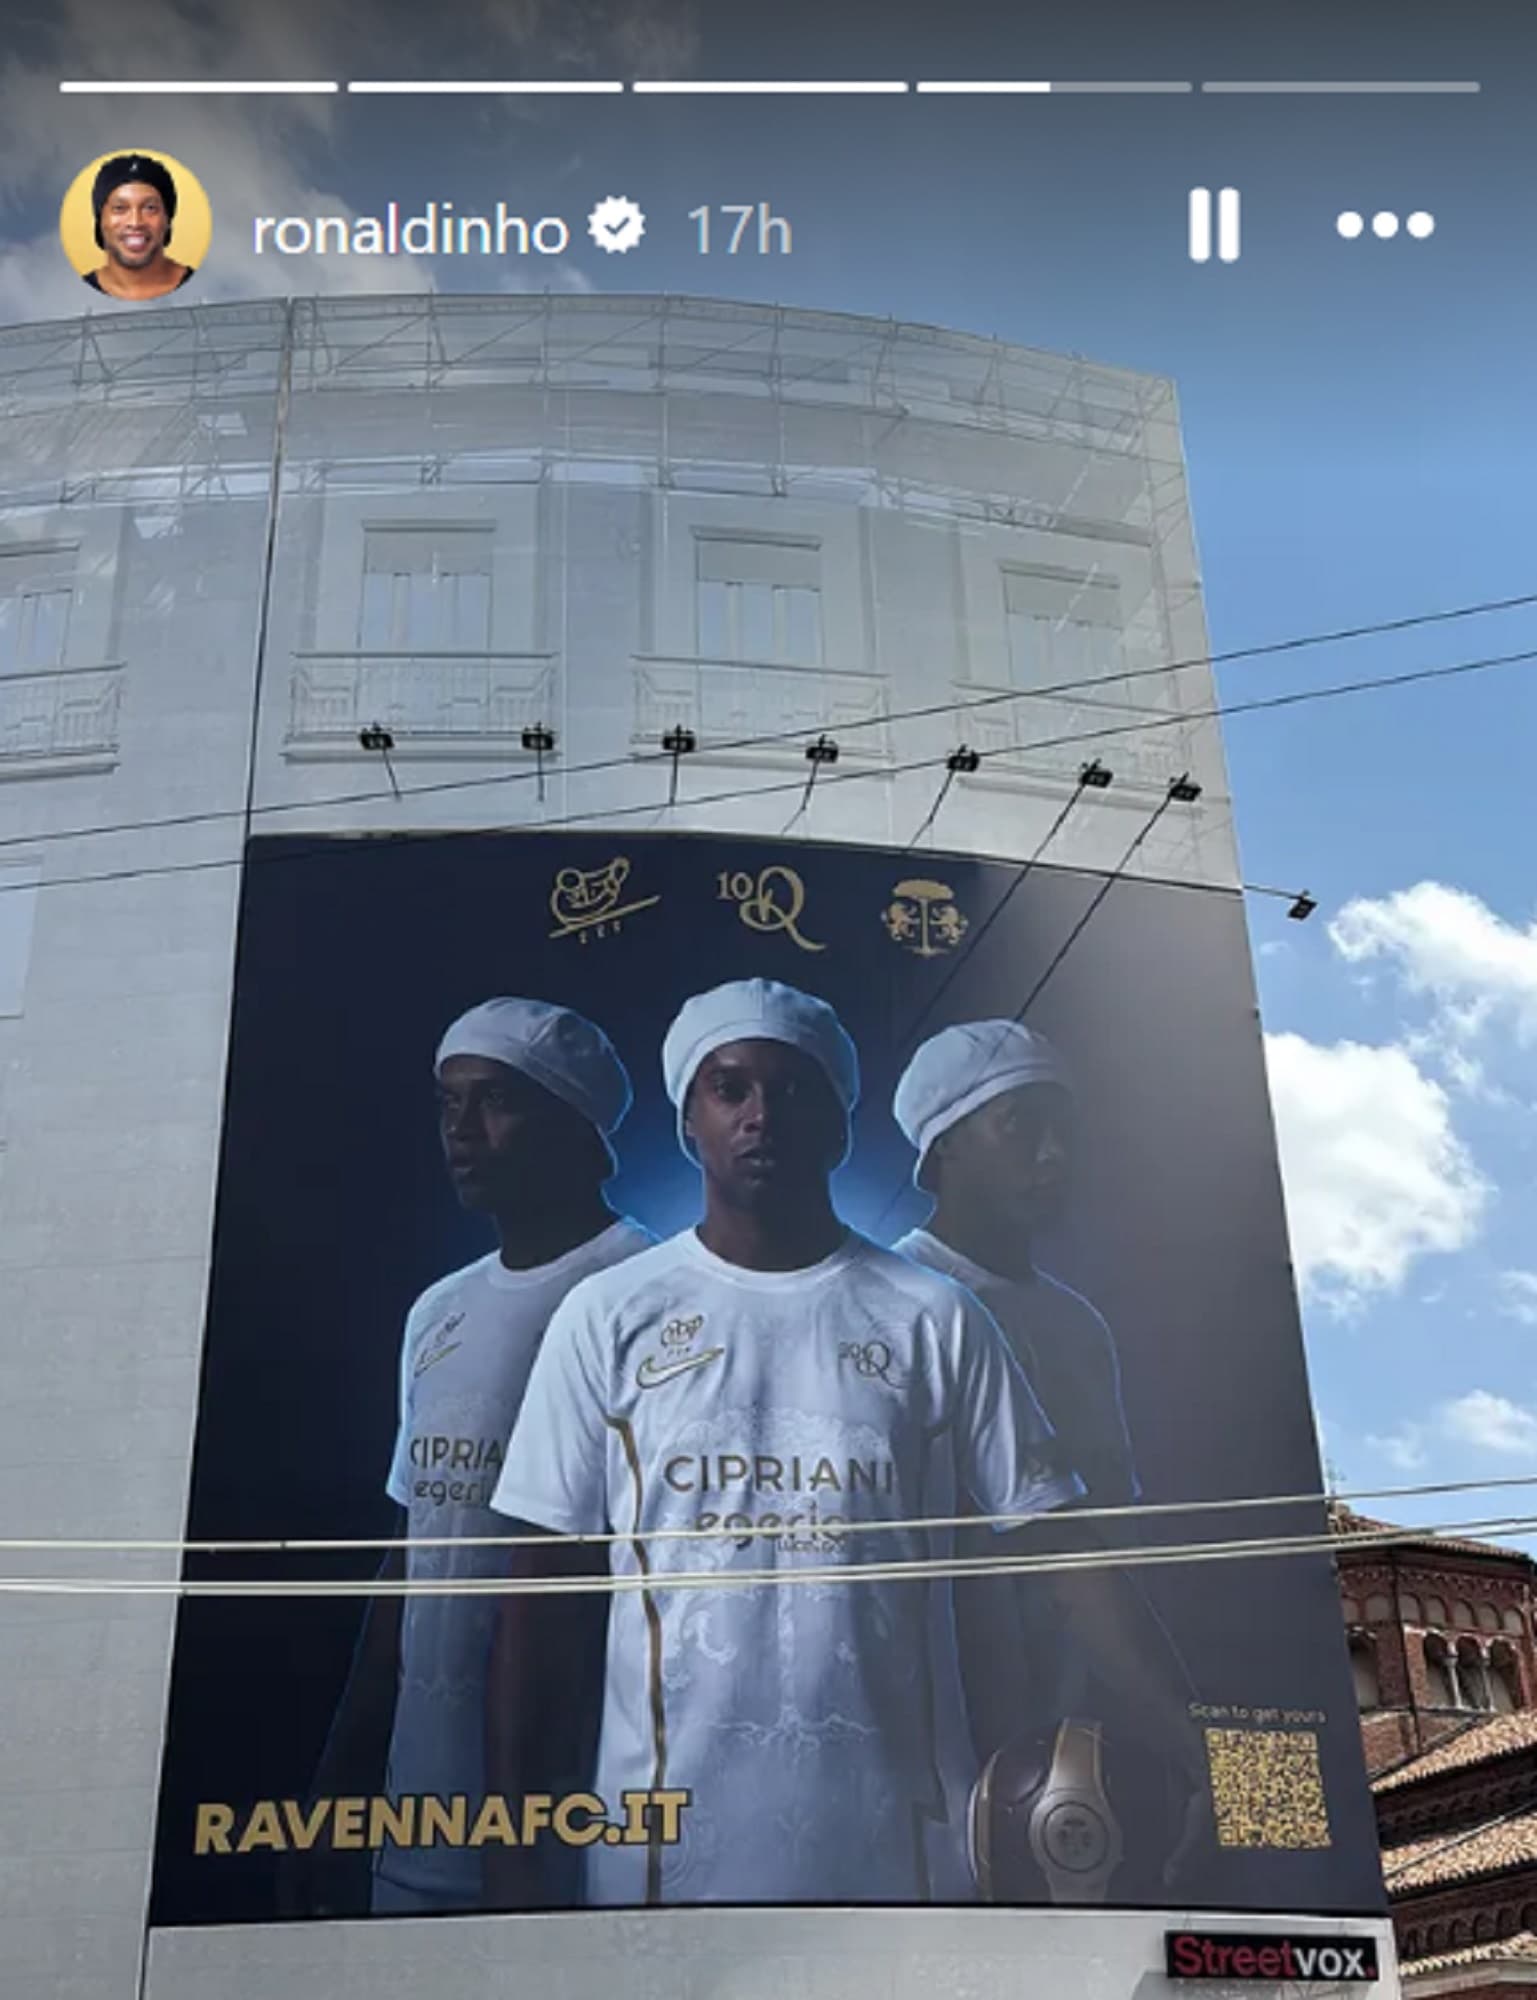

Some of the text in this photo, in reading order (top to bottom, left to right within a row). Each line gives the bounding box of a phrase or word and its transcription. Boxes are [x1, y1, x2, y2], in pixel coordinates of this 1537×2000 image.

[663, 1455, 894, 1493] CIPRIANI
[1231, 1705, 1249, 1719] to
[194, 1790, 691, 1854] RAVENNAFC.IT
